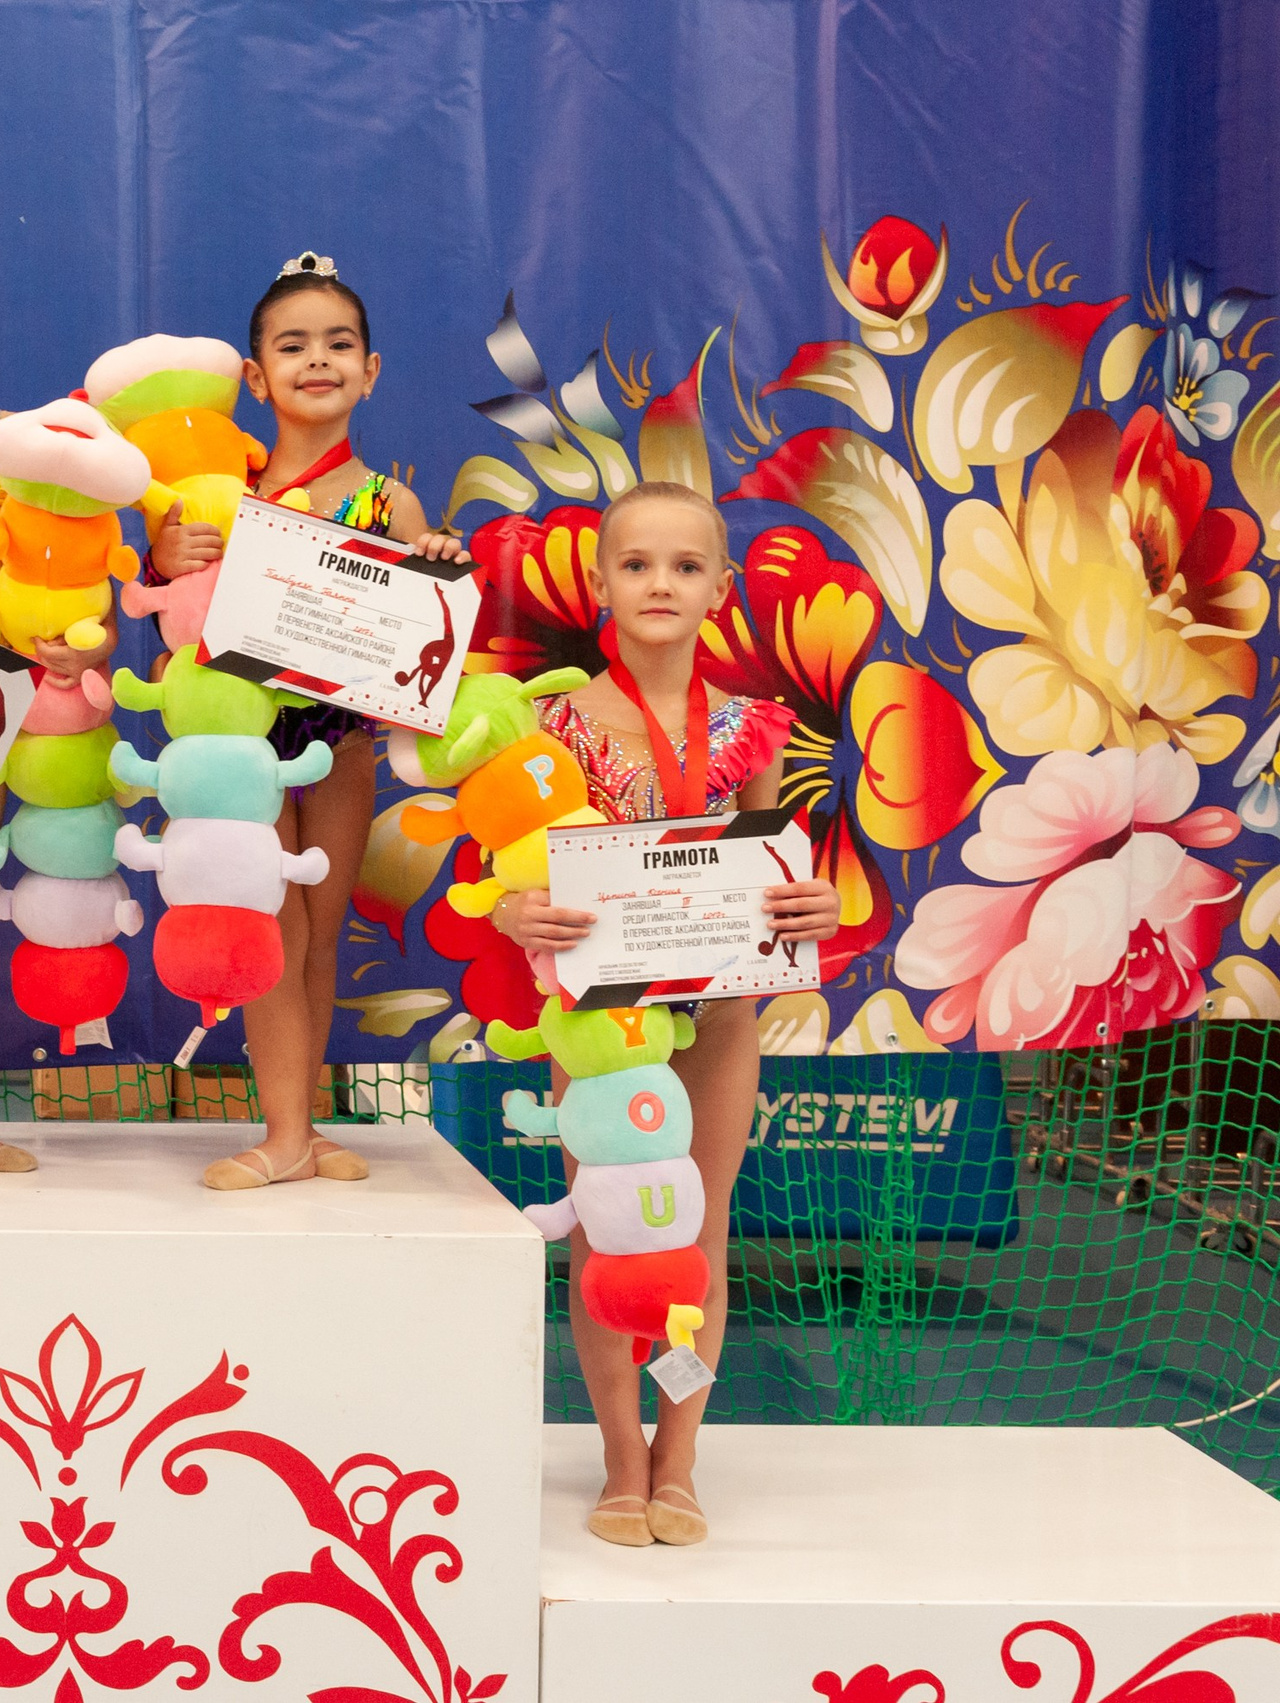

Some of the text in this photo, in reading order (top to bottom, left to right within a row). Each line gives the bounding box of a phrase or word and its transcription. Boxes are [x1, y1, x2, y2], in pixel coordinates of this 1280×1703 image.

[318, 551, 391, 586] ГРАМОТА
[332, 578, 368, 592] НАГРАЖДАЕТСЯ
[281, 600, 304, 614] СРЕДИ
[304, 607, 344, 626] ГИМНАСТОК
[285, 589, 322, 606] ЗАНЯВШАЯ
[379, 617, 402, 630] МЕСТО
[274, 625, 284, 634] ПО
[284, 628, 348, 654] ХУДОЖЕСТВЕННОЙ
[348, 646, 392, 668] ГИМНАСТИКЕ
[277, 612, 396, 655] В ПЕРВЕНСТВЕ АКСАЙСКОГО РАЙОНА
[523, 754, 555, 800] P
[643, 847, 720, 870] ГРАМОТА
[663, 872, 701, 881] НАГРАЖДАЕТСЯ
[622, 900, 662, 911] ЗАНЯВШАЯ
[723, 893, 747, 903] МЕСТО
[622, 915, 646, 924] СРЕДИ
[648, 911, 689, 923] ГИМНАСТОК
[623, 920, 750, 938] В ПЕРВЕНСТВЕ АКСАЙСКОГО РАЙОНА
[625, 934, 751, 952] ПО ХУДОЖЕСТВЕННОЙ ГИМНАСТИКЕ
[627, 1091, 666, 1133] O
[637, 1185, 676, 1228] U
